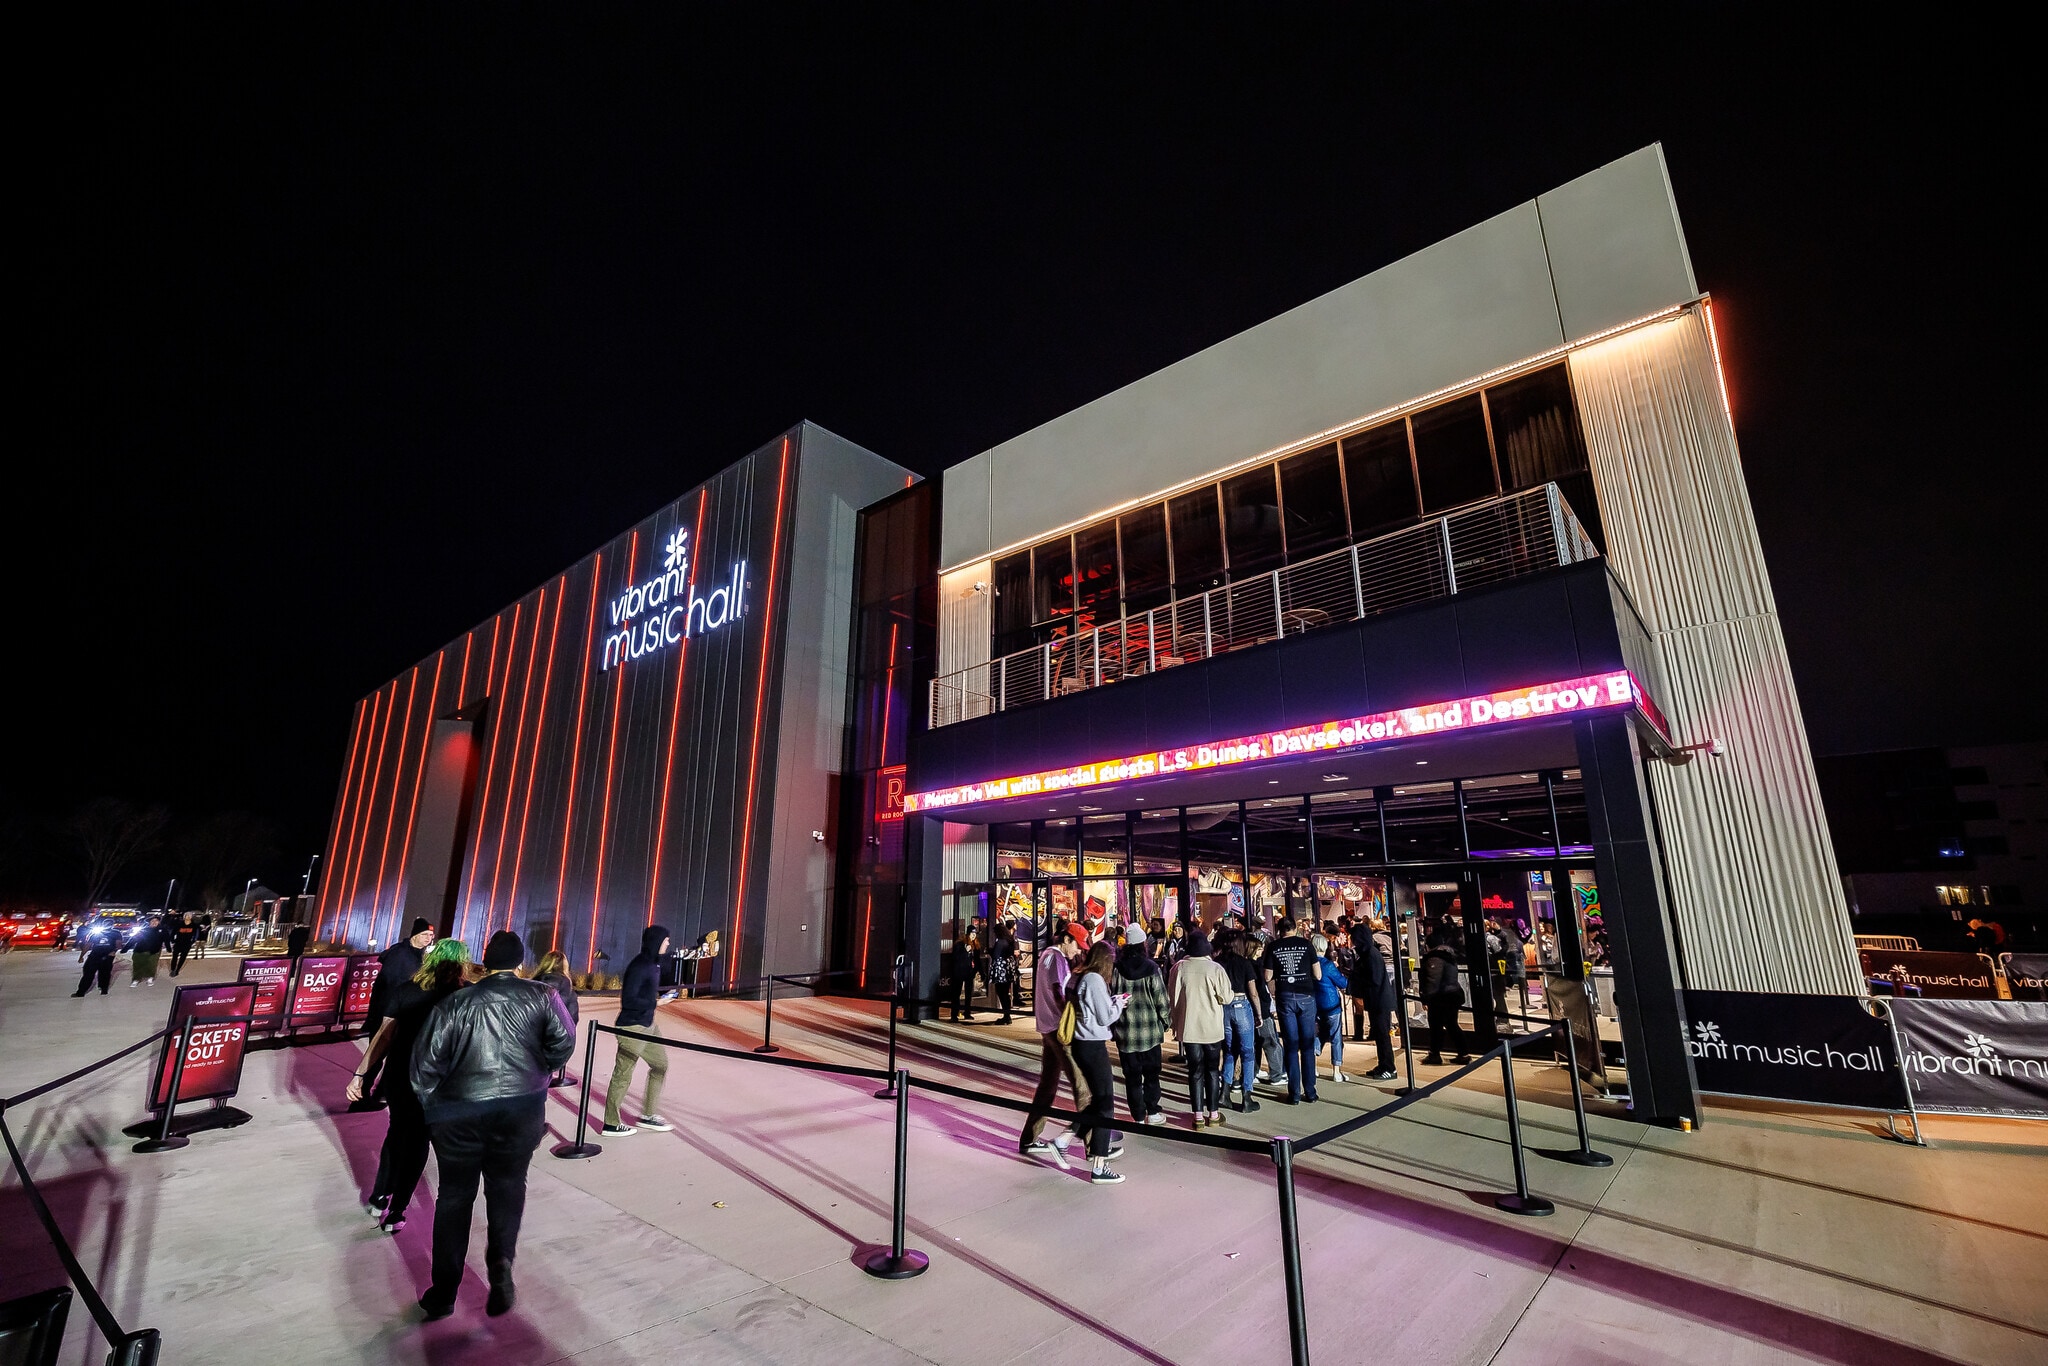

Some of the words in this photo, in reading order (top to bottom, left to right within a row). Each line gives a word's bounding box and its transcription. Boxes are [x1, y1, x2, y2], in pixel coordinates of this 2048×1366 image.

[611, 557, 688, 626] vibrant
[602, 604, 684, 671] music
[685, 560, 746, 639] hall
[961, 787, 983, 802] The
[985, 781, 1008, 798] Veil
[1010, 774, 1042, 795] with
[1044, 766, 1097, 789] special
[1099, 758, 1155, 782] guests
[1158, 751, 1193, 773] L.S.
[1409, 703, 1463, 733] and
[881, 812, 892, 820] RED
[244, 967, 288, 975] ATTENTION
[303, 972, 339, 987] BAG
[1913, 974, 1960, 986] music
[1959, 974, 1990, 988] hall
[173, 1027, 242, 1049] TCKETS
[187, 1044, 225, 1062] OUT
[1733, 1043, 1823, 1067] music
[1824, 1042, 1885, 1072] hall
